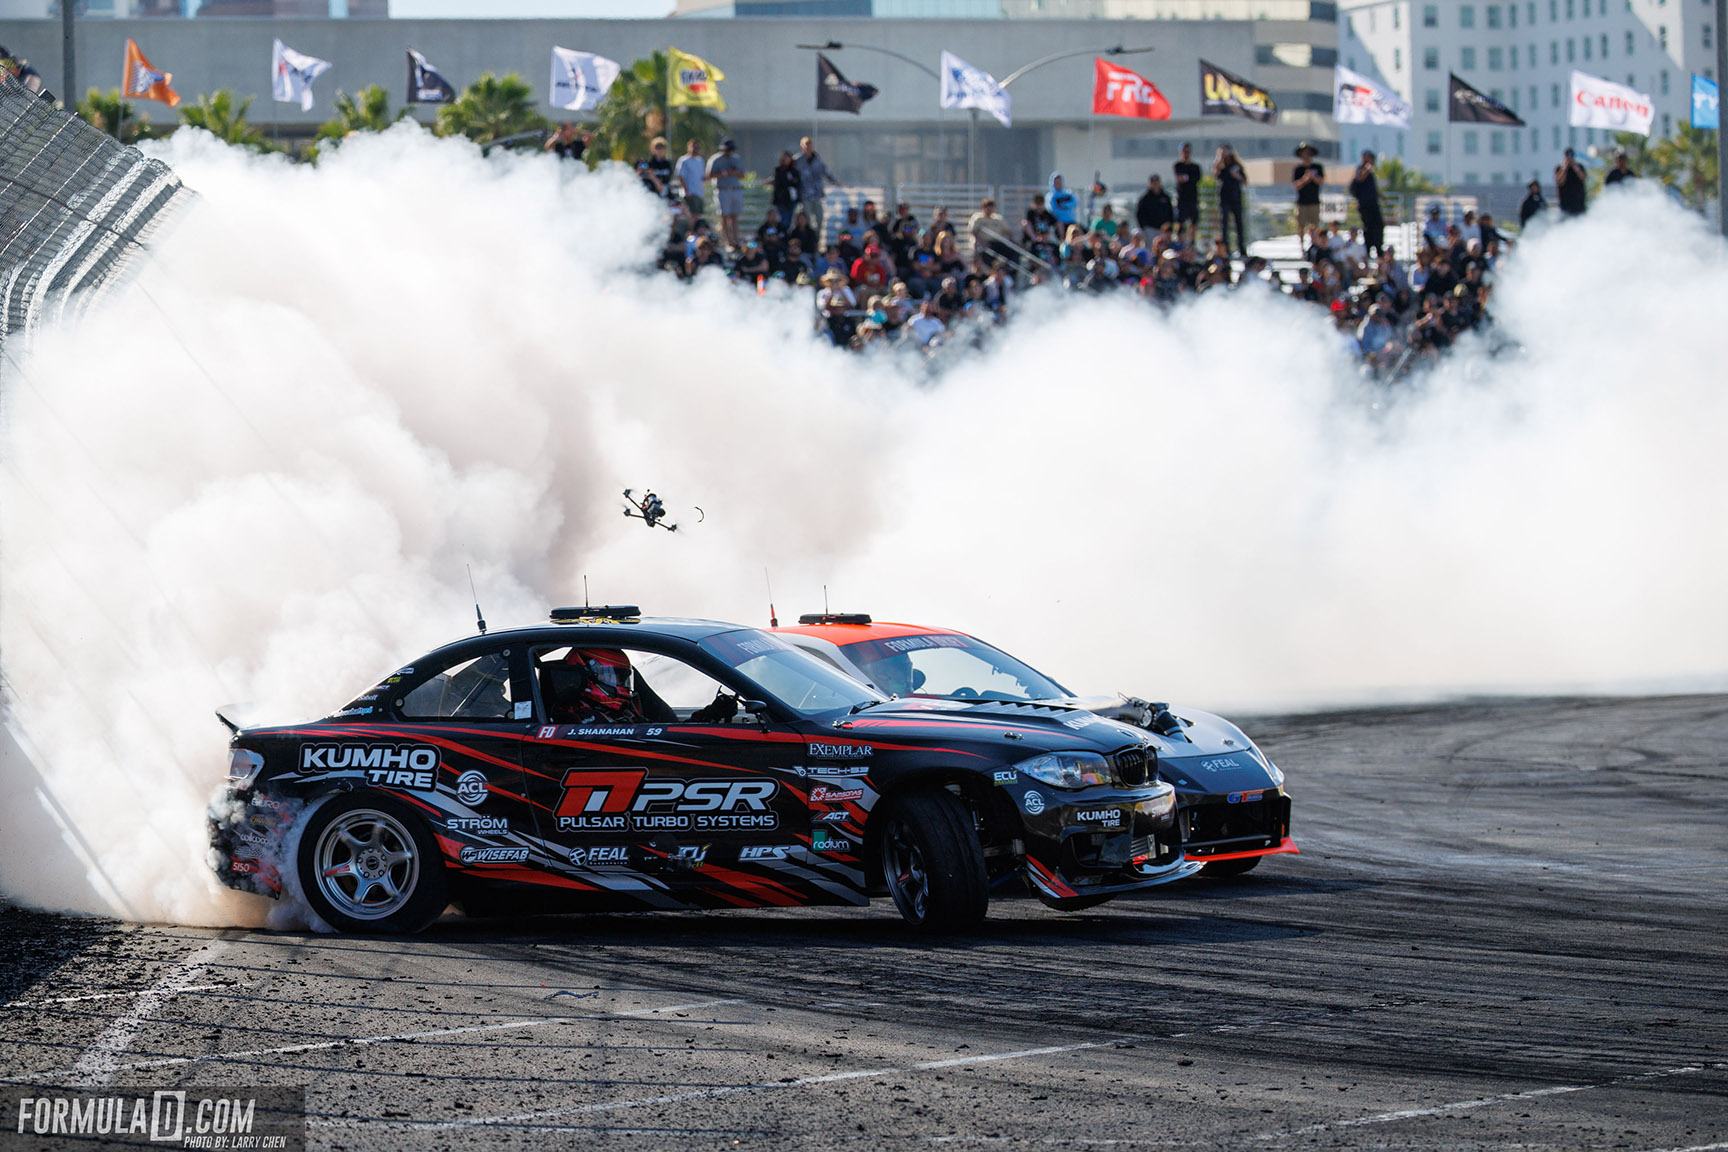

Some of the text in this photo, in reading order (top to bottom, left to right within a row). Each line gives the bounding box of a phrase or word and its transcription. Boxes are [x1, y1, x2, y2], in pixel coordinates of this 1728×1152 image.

[1576, 89, 1649, 118] Canon
[884, 636, 938, 652] FORMULA
[538, 726, 557, 739] FD
[567, 727, 663, 737] J. SHANAHAN 59
[809, 743, 873, 756] EXEMPLAR
[303, 747, 437, 771] KUMHO
[1212, 758, 1241, 769] FEAL
[369, 769, 434, 789] TIRE
[993, 770, 1018, 781] ECU
[457, 781, 489, 794] ACL
[631, 781, 776, 812] PSR
[1024, 798, 1046, 807] ACL
[559, 814, 776, 828] PULSAR TURBO SYSTEMS
[822, 811, 851, 821] ACT
[1076, 808, 1121, 822] KUMHO
[447, 815, 508, 830] STRÖM
[1101, 818, 1121, 828] TIRE
[476, 847, 530, 861] WISEFAB
[588, 846, 630, 861] FEAL
[739, 845, 791, 861] HPS
